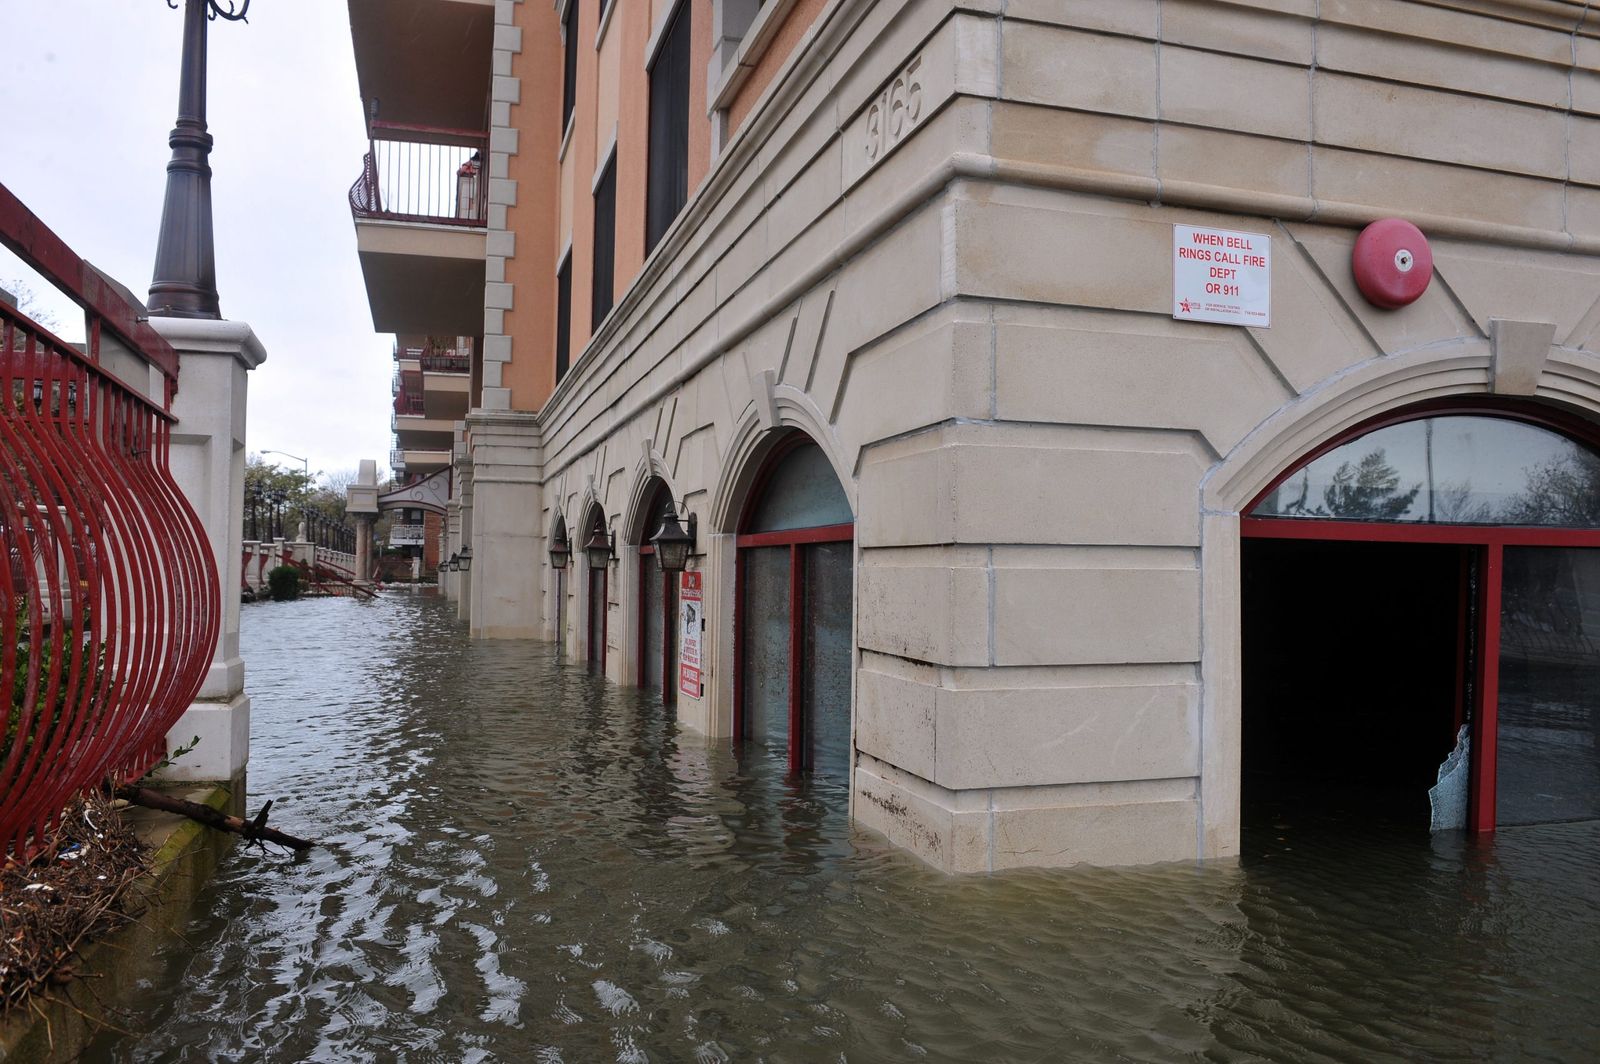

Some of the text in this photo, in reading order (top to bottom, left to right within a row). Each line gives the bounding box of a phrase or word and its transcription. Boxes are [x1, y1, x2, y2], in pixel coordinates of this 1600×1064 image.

[865, 55, 922, 164] 3165
[1193, 233, 1252, 250] WHEN BELL
[1179, 247, 1265, 268] RINGS CALL FIRE
[1209, 267, 1236, 280] DEPT
[1205, 283, 1239, 296] OR 911
